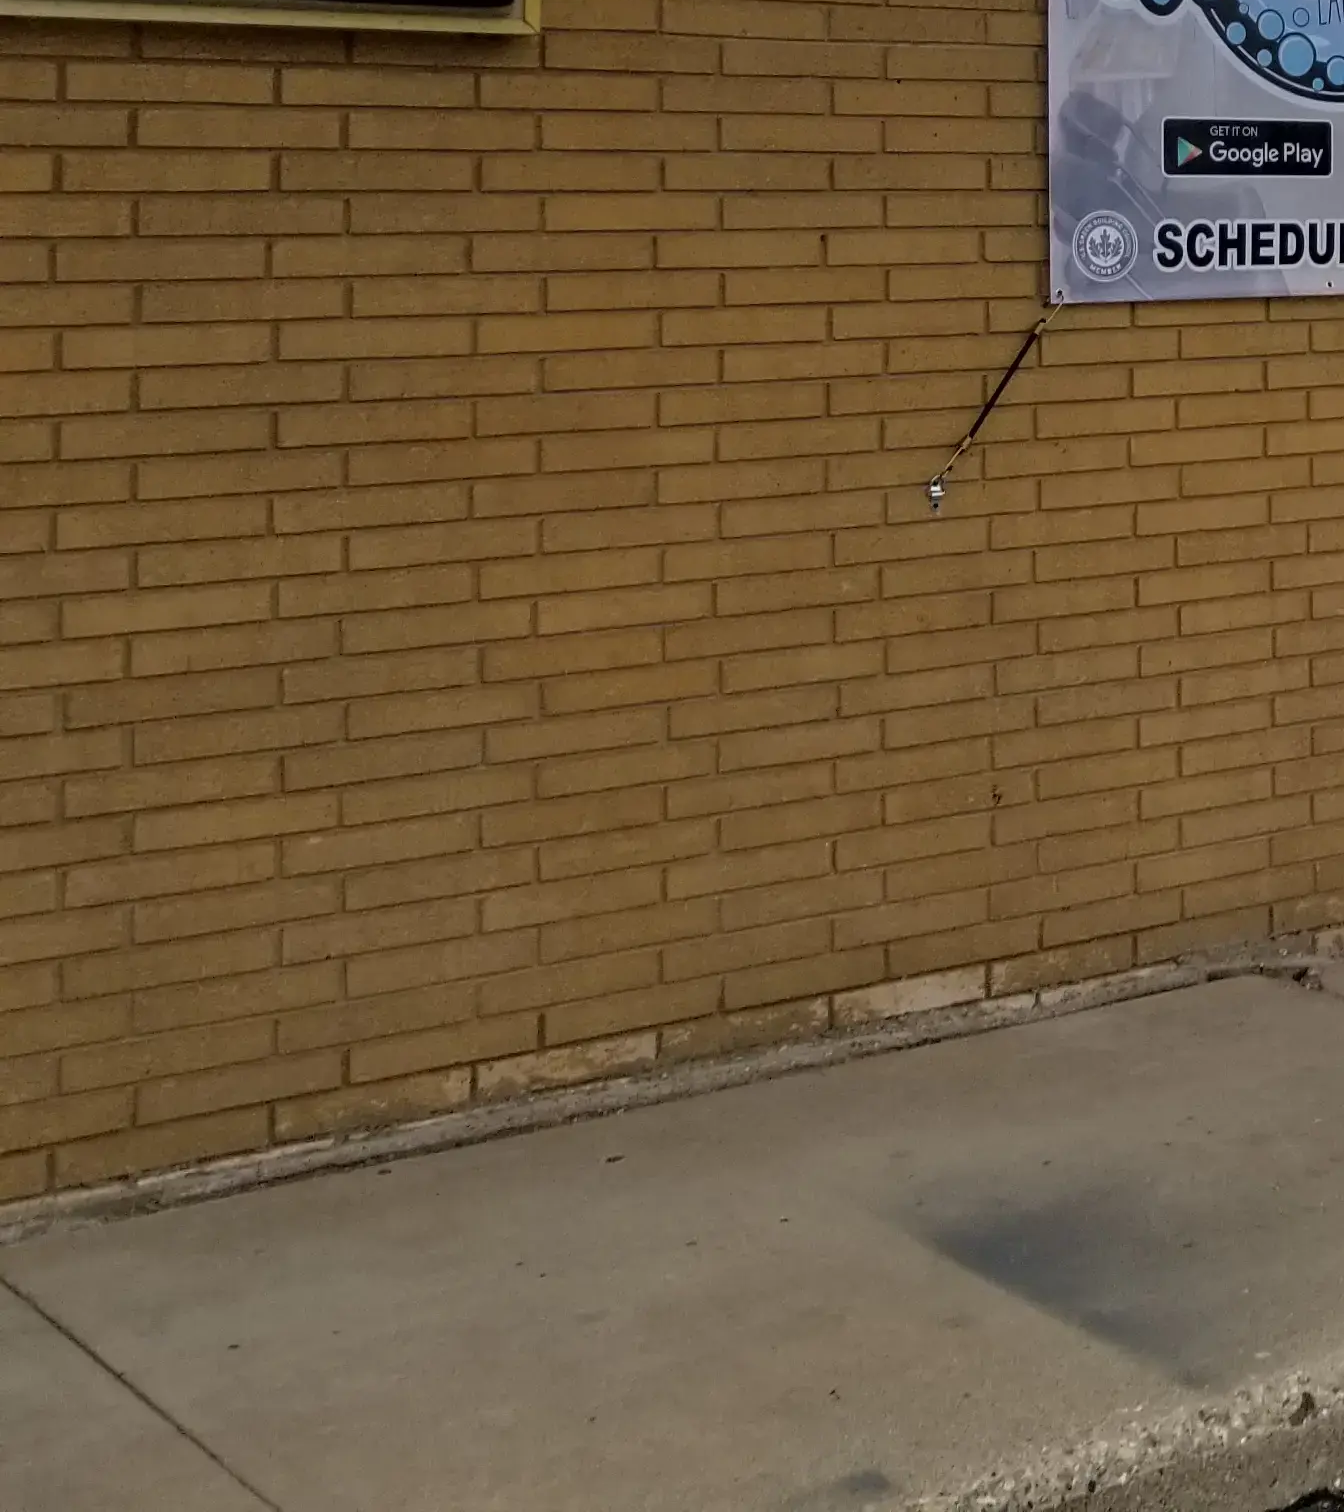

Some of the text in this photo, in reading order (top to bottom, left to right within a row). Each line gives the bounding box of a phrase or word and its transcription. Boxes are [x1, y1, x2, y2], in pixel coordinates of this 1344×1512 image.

[1210, 125, 1259, 137] GET IT ON
[1209, 140, 1323, 168] Google Play
